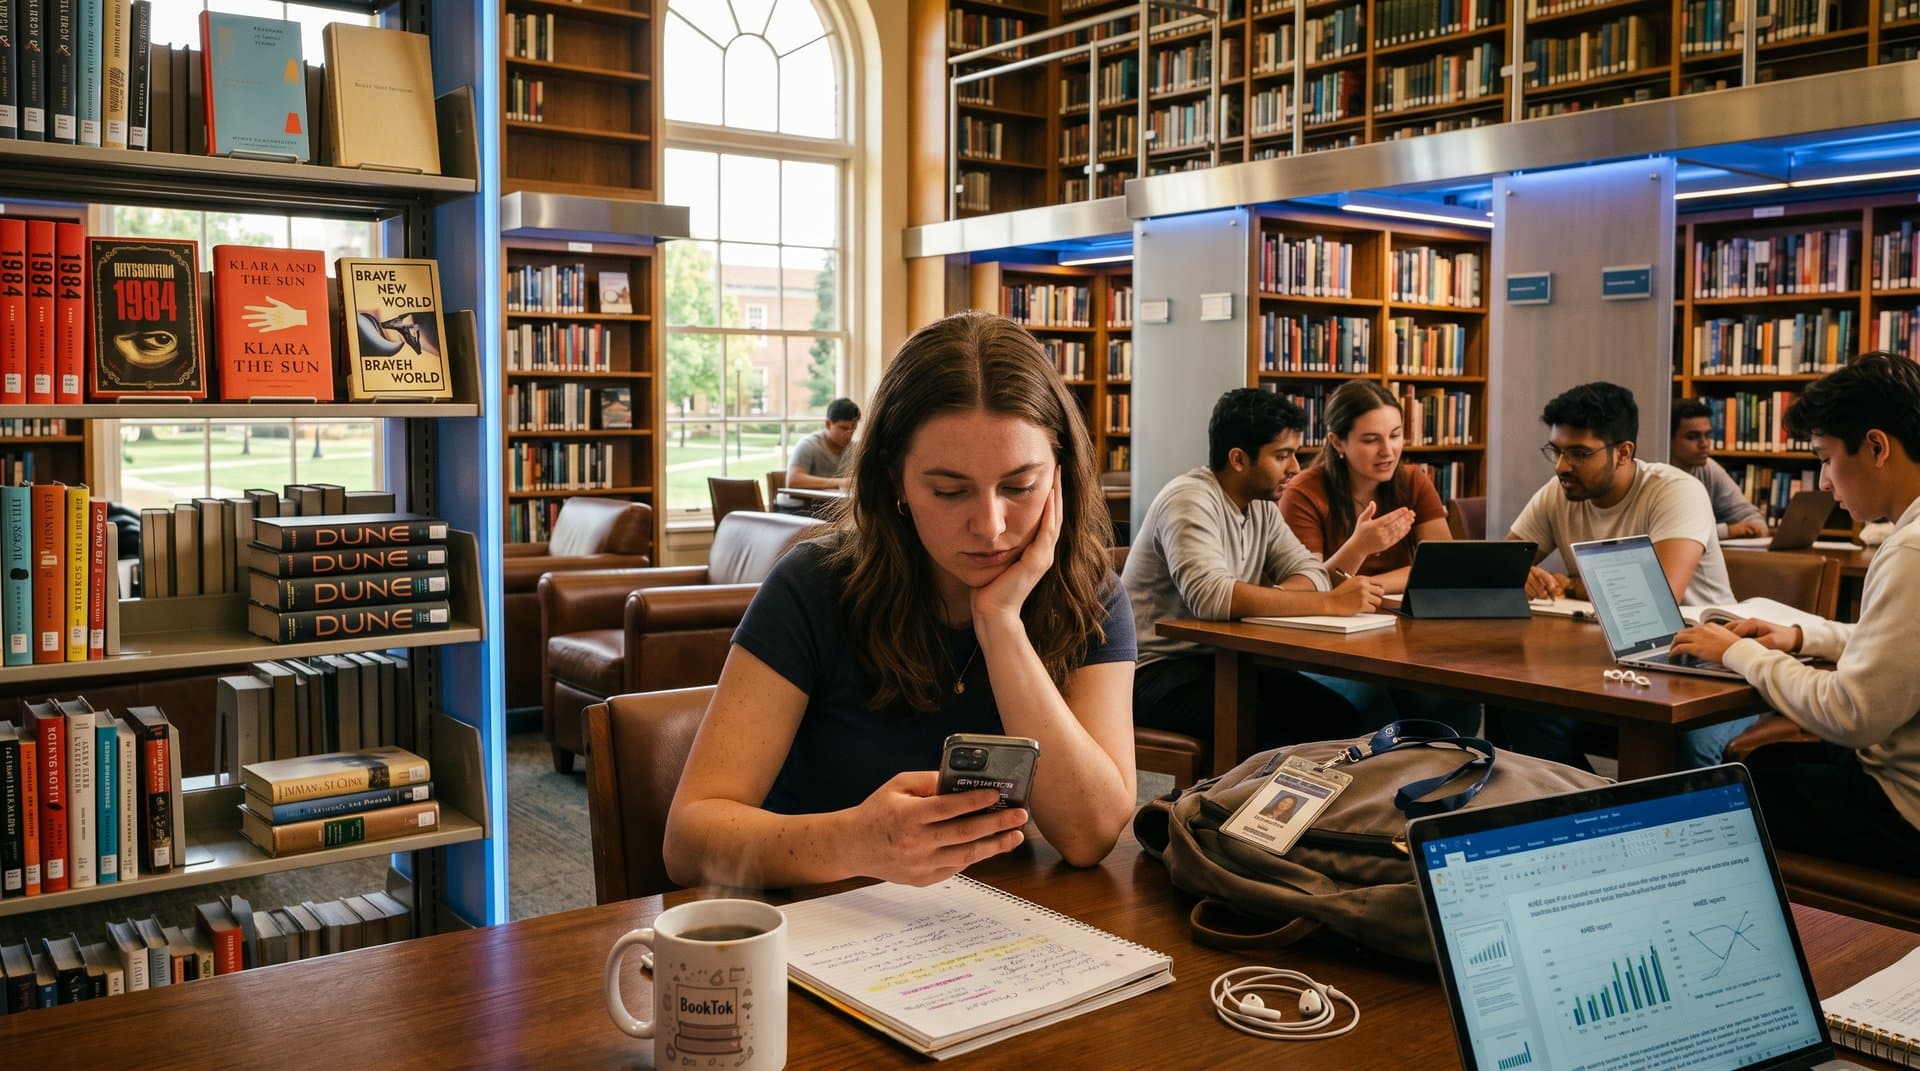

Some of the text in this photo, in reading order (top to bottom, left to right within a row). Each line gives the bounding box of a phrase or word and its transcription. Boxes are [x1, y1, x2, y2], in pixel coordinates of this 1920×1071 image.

[2, 250, 24, 297] 1984
[229, 259, 317, 273] KLARA AND
[31, 251, 53, 299] 1984
[60, 253, 82, 300] 1984
[241, 274, 305, 287] THE SUN
[355, 270, 397, 282] BRAVE
[377, 283, 407, 295] NEW
[113, 280, 177, 322] 1984
[382, 296, 432, 308] WORLD
[243, 342, 311, 356] KLARA
[233, 359, 320, 374] THE SUN
[364, 359, 413, 371] BRAYEH
[391, 372, 440, 384] WORLD
[315, 525, 410, 546] DUNE
[312, 550, 409, 573] DUNE
[314, 577, 413, 604] DUNE
[315, 609, 413, 636] DUNE
[680, 997, 734, 1015] BookTok
